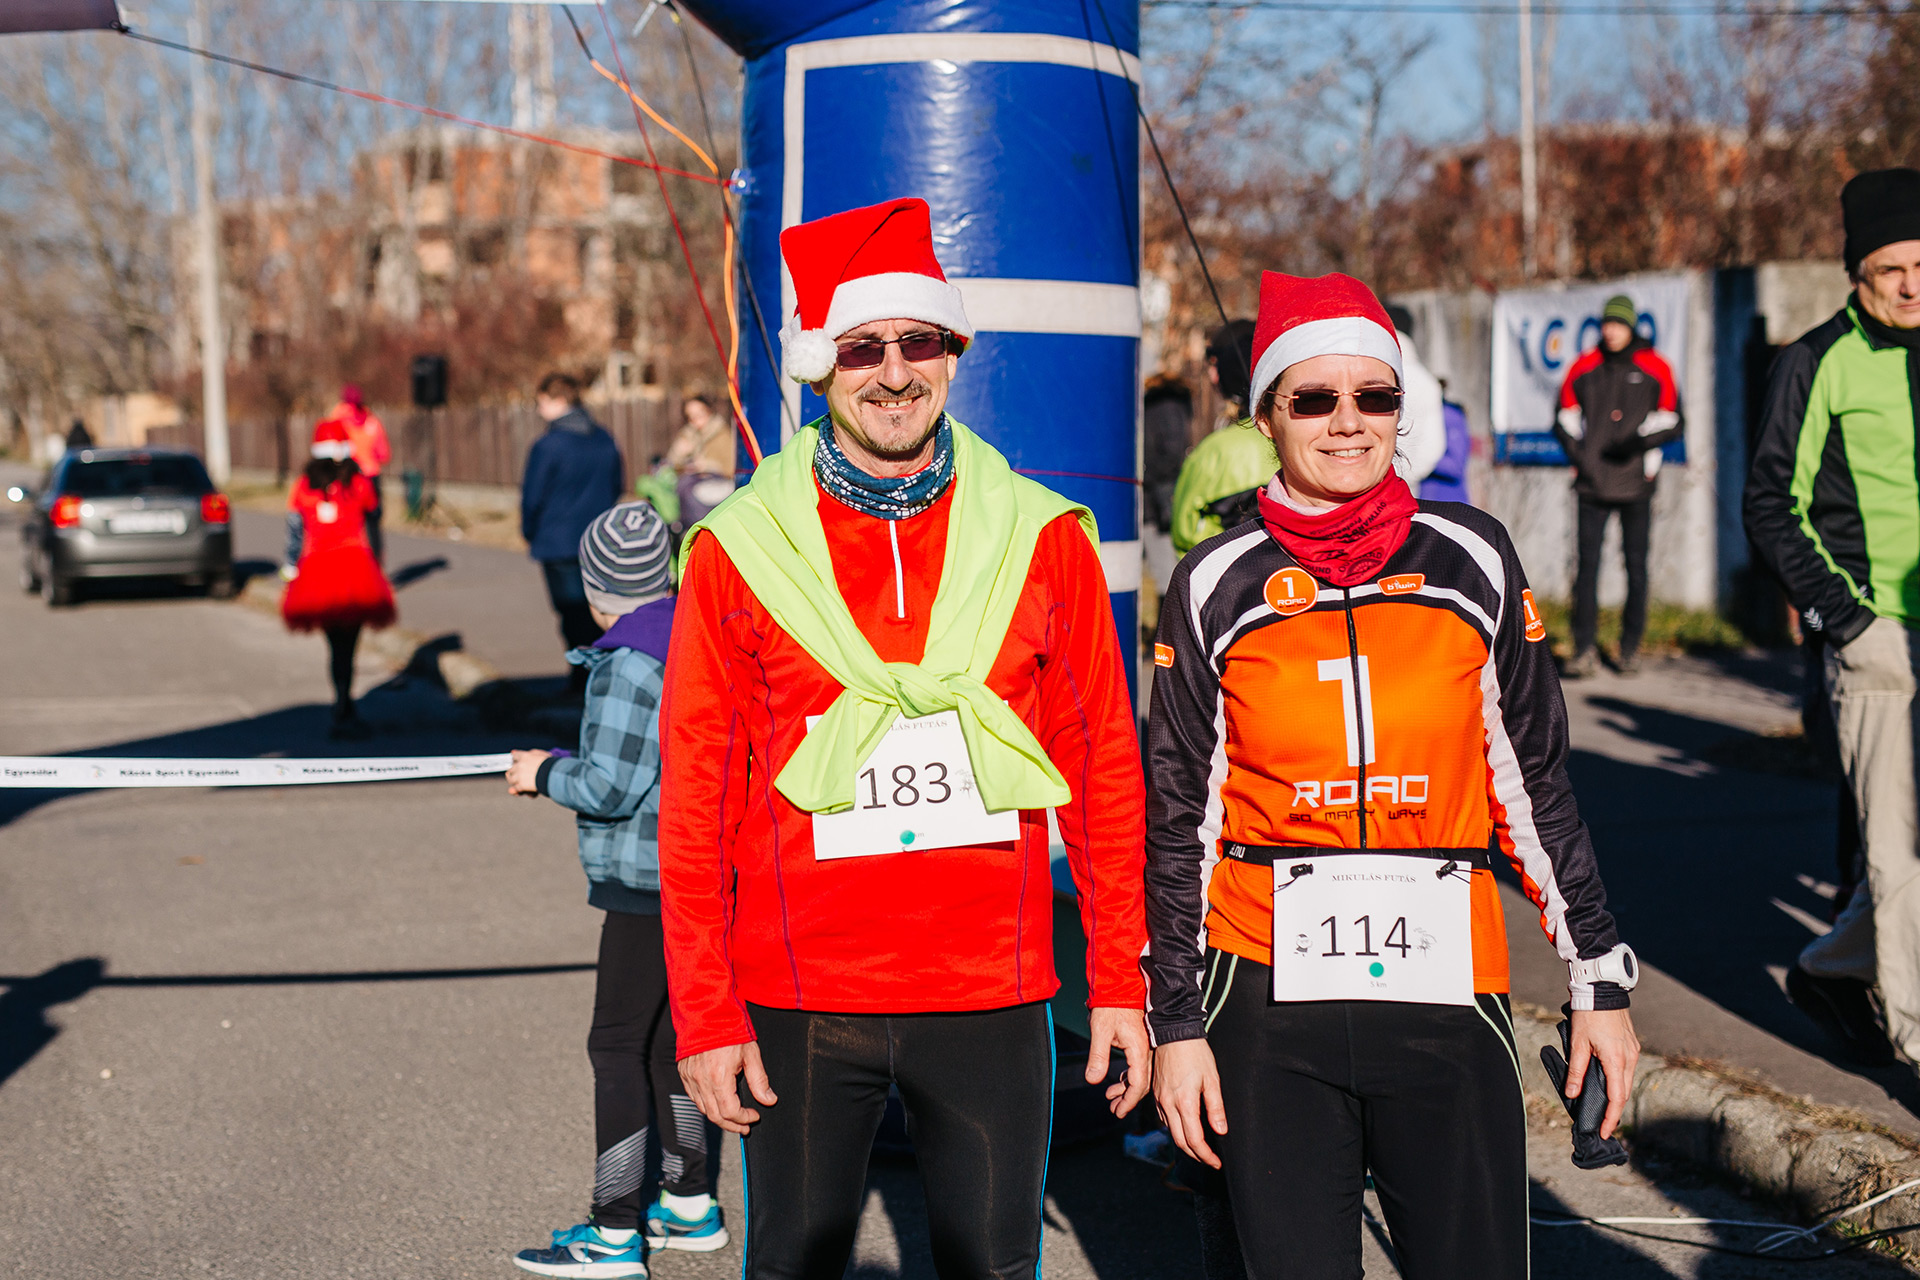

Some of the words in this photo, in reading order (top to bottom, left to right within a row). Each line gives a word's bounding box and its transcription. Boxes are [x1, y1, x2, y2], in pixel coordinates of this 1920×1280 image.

[1282, 576, 1295, 598] 1
[1277, 597, 1307, 606] ROAD
[1523, 598, 1536, 621] 1
[1317, 655, 1376, 768] 1
[912, 720, 948, 730] FUTÁS
[860, 762, 952, 810] 183
[1291, 774, 1430, 808] ROAD
[1388, 809, 1427, 820] WAYS
[1331, 872, 1382, 882] MIKULÁS
[1384, 874, 1417, 883] FUTÁS
[1320, 915, 1412, 958] 114
